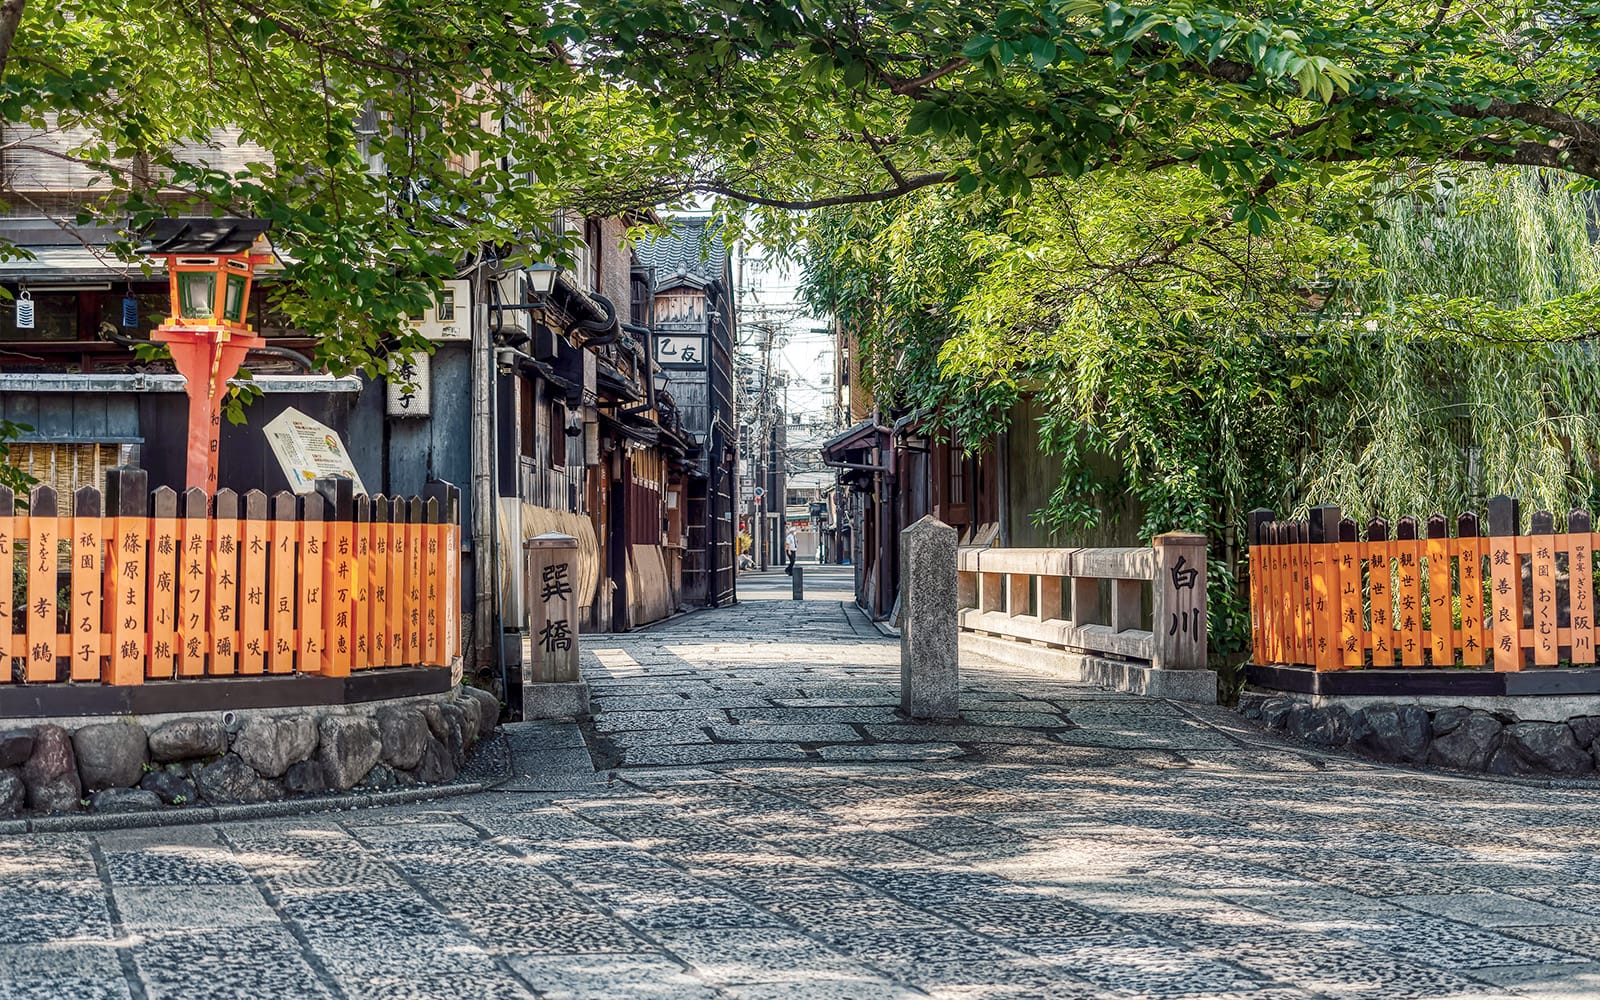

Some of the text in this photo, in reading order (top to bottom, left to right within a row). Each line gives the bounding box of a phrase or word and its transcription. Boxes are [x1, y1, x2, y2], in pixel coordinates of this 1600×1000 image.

[660, 338, 700, 363] 乙友
[32, 532, 53, 663] ぎをん孝鶴
[78, 532, 96, 662] 祇園てる子
[121, 533, 142, 661] 篠原まめ鶴
[154, 534, 173, 660] 藤廣小桃
[186, 533, 204, 658] 岸本フク愛
[216, 534, 235, 656] 藤本君彌
[246, 535, 264, 656] 木村咲
[306, 535, 321, 653] 志ばた
[336, 536, 350, 654] 岩井万須恵
[358, 536, 368, 653] 蒲公英
[375, 536, 386, 651] 桔梗家
[393, 537, 402, 649] 佐野
[538, 562, 573, 653] 巽橋
[1169, 555, 1200, 643] 白川
[1313, 560, 1327, 653] 一力亭
[1343, 554, 1358, 652] 片山清愛
[1371, 555, 1388, 652] 観世淳夫
[1400, 552, 1417, 652] 観世安寿子
[1432, 552, 1446, 651] いづう
[1462, 550, 1480, 652] 割烹さか本
[1494, 549, 1513, 652] 鍵善良房
